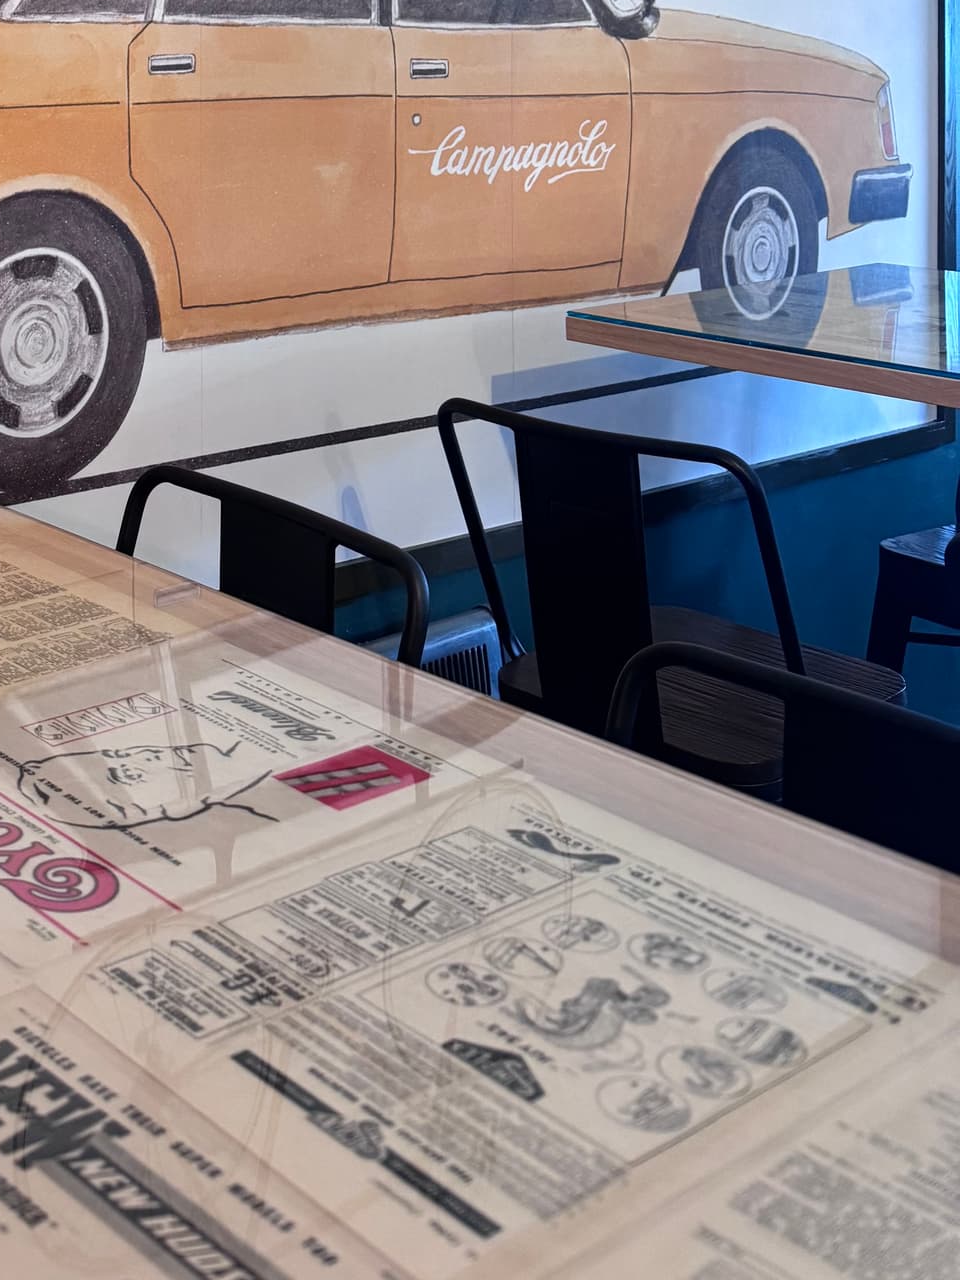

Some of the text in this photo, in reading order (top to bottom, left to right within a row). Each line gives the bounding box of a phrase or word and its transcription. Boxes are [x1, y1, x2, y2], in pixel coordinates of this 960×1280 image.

[34, 776, 66, 792] ONLY
[59, 792, 84, 804] THE
[81, 805, 108, 819] NOT
[147, 846, 184, 866] WHEN
[13, 1025, 77, 1071] BICYCLES
[79, 1075, 118, 1102] HAVE
[169, 1140, 223, 1180] SUPER
[69, 1156, 158, 1211] NEW
